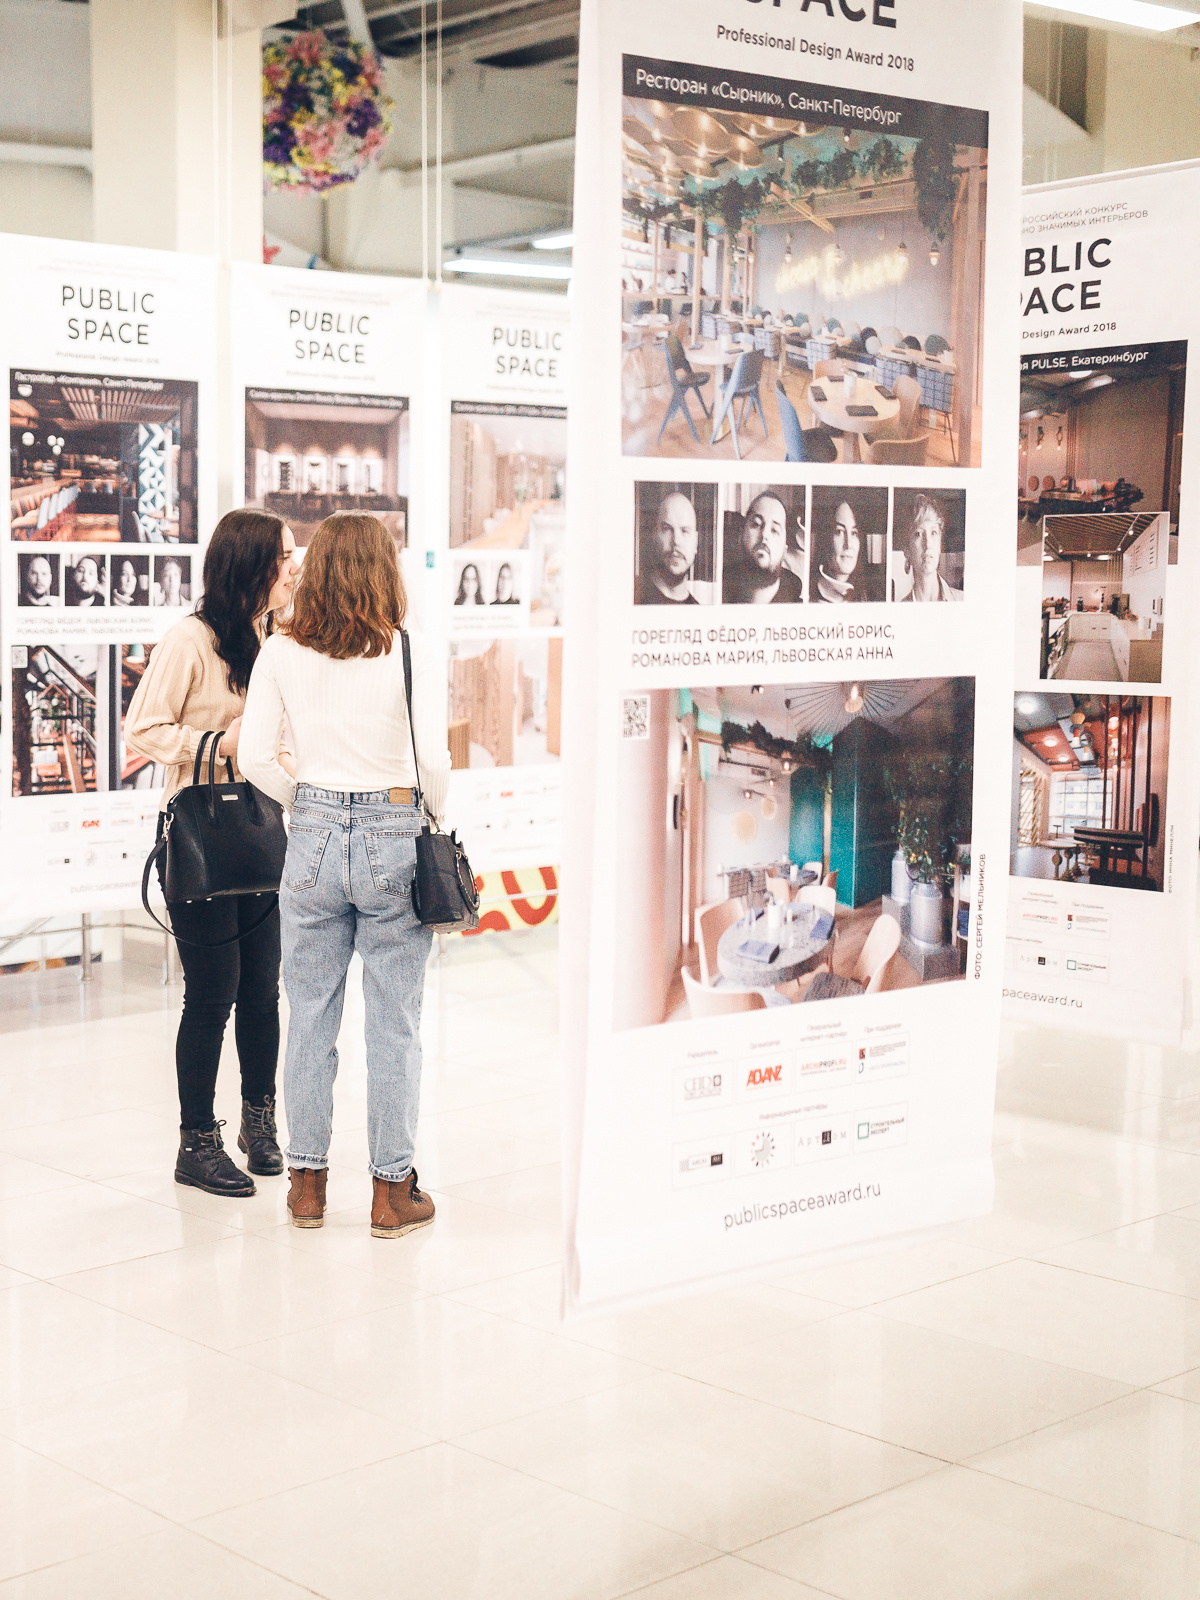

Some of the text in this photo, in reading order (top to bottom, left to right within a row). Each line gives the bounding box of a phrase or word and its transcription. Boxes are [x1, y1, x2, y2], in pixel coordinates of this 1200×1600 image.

[717, 24, 915, 72] Professional Design Award 2018
[636, 67, 901, 125] Ресторан «Сырник», Санкт-Петербург
[1022, 203, 1128, 224] РОССИЙСКИЙ КОНКУРС
[1038, 220, 1086, 232] ЗНАЧИМЫХ
[1089, 210, 1148, 225] ИНТЕРЬЕРОВ
[1024, 238, 1112, 277] BLIC
[62, 284, 155, 314] PUBLIC
[68, 318, 150, 345] SPACE
[289, 309, 370, 335] PUBLIC
[1022, 322, 1117, 339] Design Award 2018
[492, 326, 562, 351] PUBLIC
[295, 339, 366, 364] SPACE
[1032, 357, 1068, 369] PULSE,
[1071, 351, 1149, 367] Екатеринбург
[496, 355, 557, 378] SPACE
[632, 623, 895, 646] ГОРЕГЛЯД ФЁДОР, ЛЬВОВСКИЙ БОРИС,
[632, 647, 894, 668] РОМАНОВА МАРИЯ, ЛЬВОВСКАЯ АННА
[978, 854, 986, 911] МЕЛЬНИКОВ
[1002, 988, 1083, 1008] paceaward.ru
[724, 1183, 881, 1231] publicspaceaward.ru
